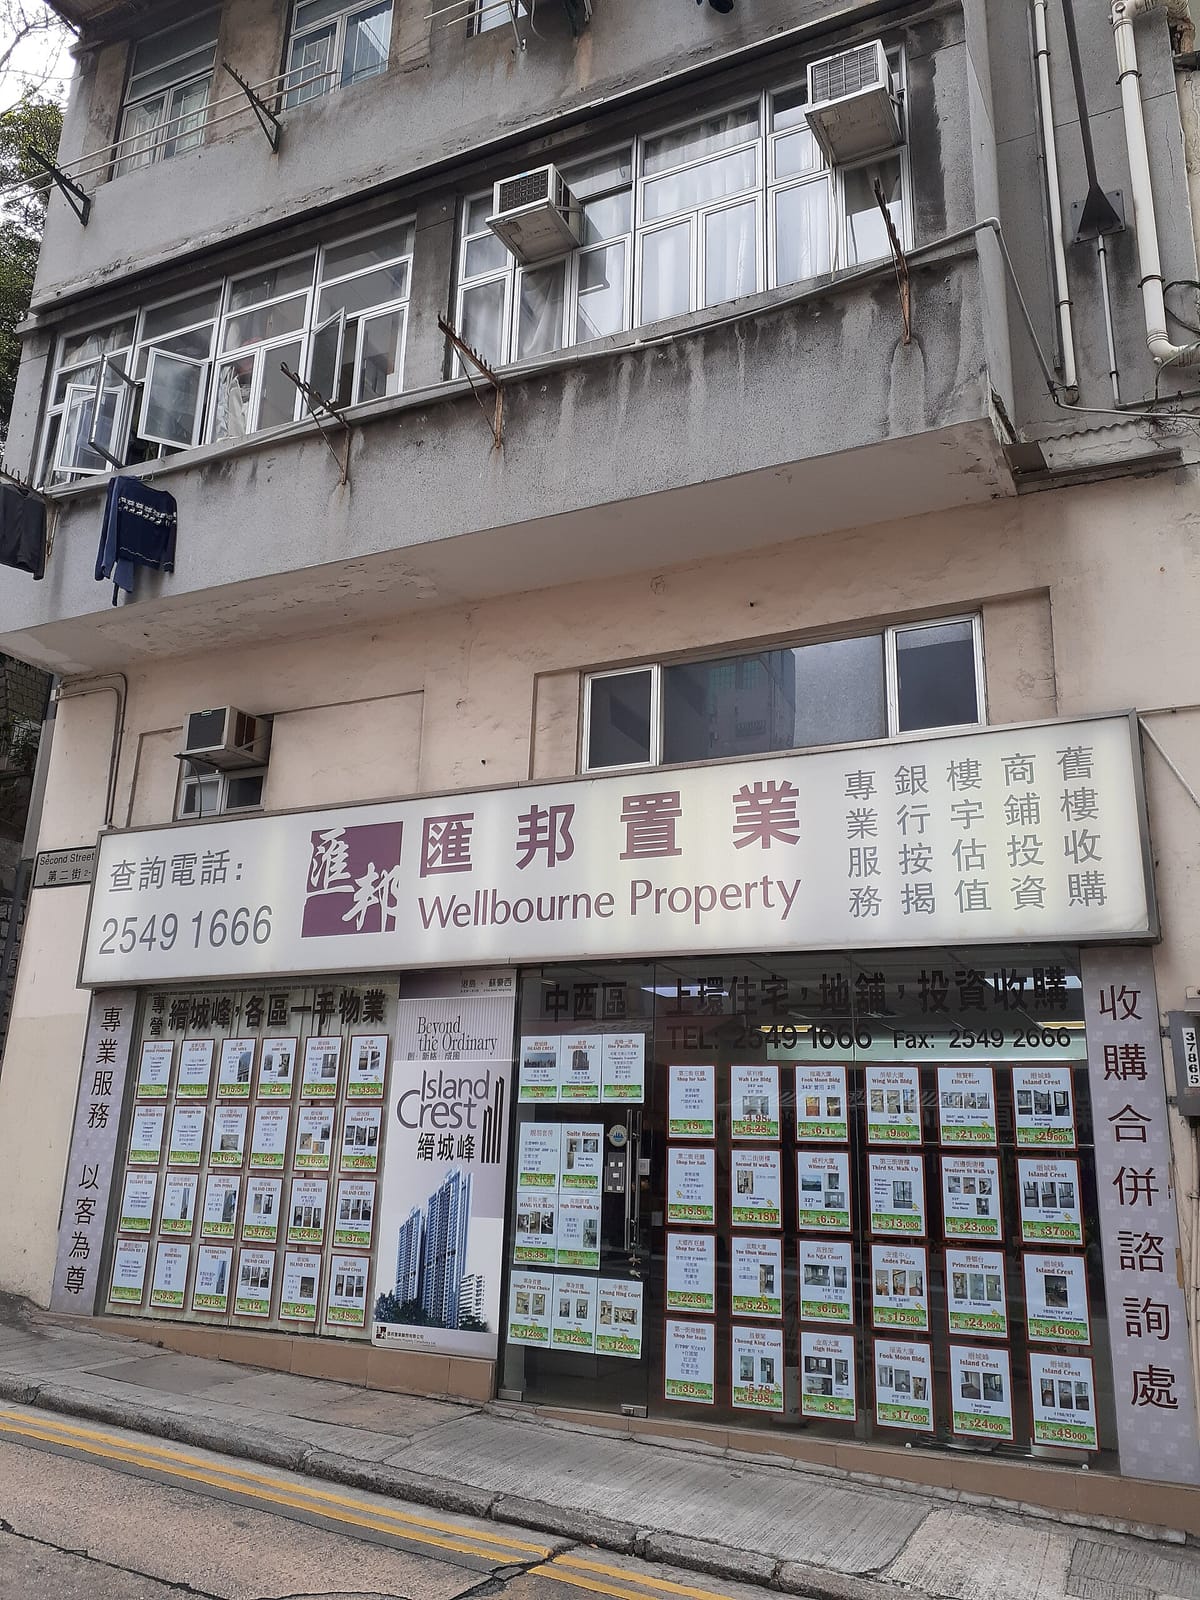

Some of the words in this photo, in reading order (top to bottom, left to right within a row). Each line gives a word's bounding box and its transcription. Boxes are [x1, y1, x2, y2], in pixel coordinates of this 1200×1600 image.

[419, 780, 801, 878] 匯邦置業
[894, 764, 936, 915] 銀行按揭
[947, 758, 992, 913] 樓宇估值
[1000, 752, 1047, 910] 商鋪投資
[1056, 745, 1107, 907] 舊樓收購
[40, 854, 68, 866] Second
[70, 852, 95, 863] Street
[844, 769, 882, 918] 專業服務
[48, 868, 81, 882] 第二街
[417, 888, 615, 930] Wellbourne
[629, 875, 802, 925] Property
[99, 912, 179, 955] 2549
[191, 904, 273, 949] 1666
[545, 980, 628, 1022] 中西區
[416, 1015, 461, 1036] Beyond
[732, 1024, 798, 1050] 2549
[806, 1024, 872, 1049] 1666
[893, 1029, 935, 1049] Fax:
[949, 1028, 1004, 1048] 2549
[1012, 1027, 1071, 1048] 2666
[418, 1033, 439, 1052] the
[441, 1032, 498, 1056] Ordinary
[1185, 1031, 1199, 1084] 37865
[87, 1006, 123, 1129] 專業服務
[420, 1068, 490, 1102] Island
[396, 1089, 477, 1130] Crest
[416, 1131, 476, 1163] 縉城峰
[64, 1163, 99, 1295] 以客為尊
[1040, 1225, 1075, 1237] $37000
[1044, 1324, 1080, 1336] $46000
[812, 1345, 826, 1353] High
[959, 1358, 980, 1367] Island
[981, 1360, 999, 1369] Crest
[1042, 1367, 1062, 1376] Island
[1063, 1369, 1081, 1377] Crest
[969, 1417, 1004, 1431] $24000
[1051, 1427, 1088, 1440] $48000
